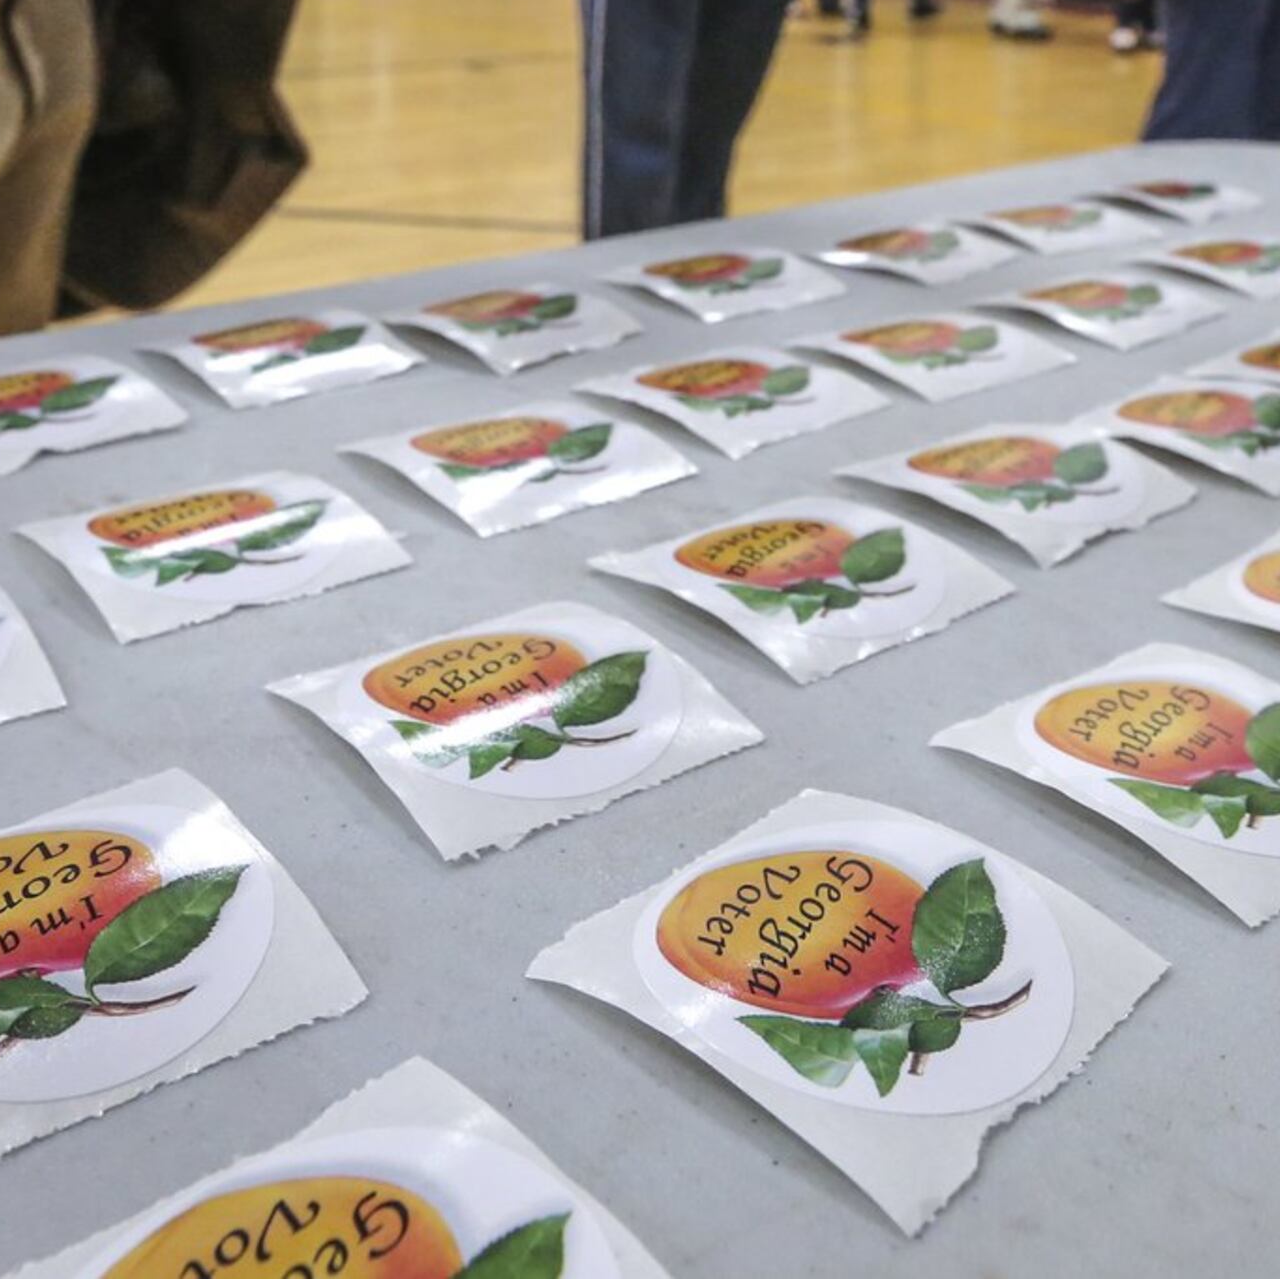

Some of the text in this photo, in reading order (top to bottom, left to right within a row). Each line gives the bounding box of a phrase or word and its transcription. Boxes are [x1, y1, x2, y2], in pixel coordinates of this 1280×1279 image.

[393, 640, 503, 688] Voter
[409, 638, 556, 713] Georgia
[477, 692, 497, 706] a
[1069, 687, 1150, 741] Voter
[1112, 684, 1211, 769] Georgia
[1174, 744, 1196, 761] a
[31, 894, 104, 936] I'm
[697, 864, 801, 956] Voter
[747, 856, 873, 998] Georgia
[825, 908, 900, 977] I'm a
